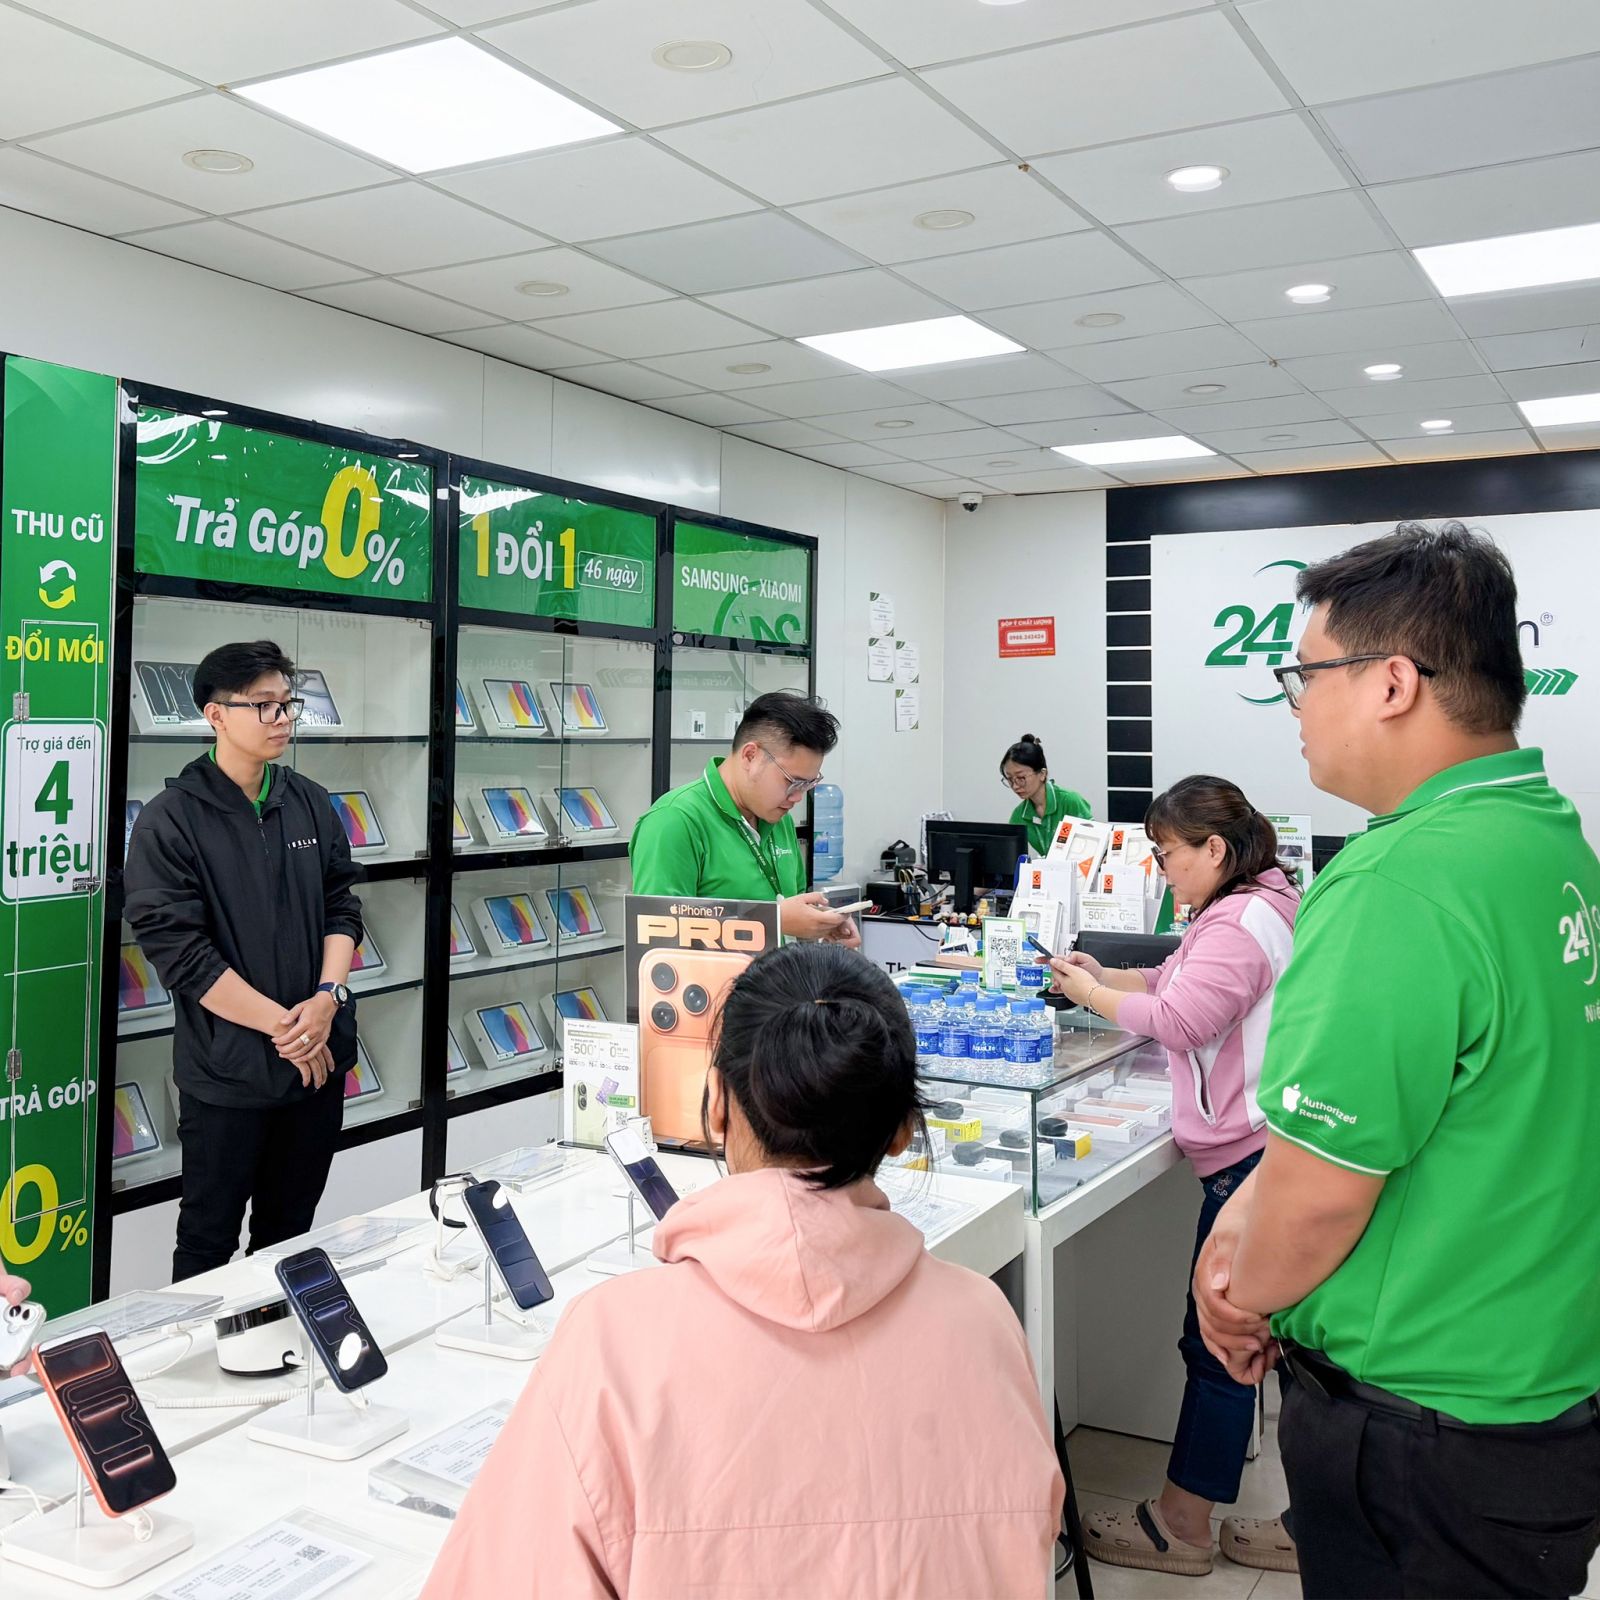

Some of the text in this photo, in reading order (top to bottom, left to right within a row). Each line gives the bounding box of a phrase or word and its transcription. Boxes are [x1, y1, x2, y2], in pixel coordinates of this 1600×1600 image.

[11, 508, 104, 543] THU CŨ
[173, 494, 238, 549] Trả
[248, 507, 325, 569] Góp
[495, 520, 554, 582] ĐỔI
[559, 527, 576, 590] 1
[584, 558, 639, 589] 46 ngày
[681, 565, 749, 595] SAMSUNG
[759, 578, 802, 603] XIAOMI
[5, 628, 104, 664] ĐỔI MỚI
[17, 734, 91, 754] Trợ giá đến
[34, 760, 74, 825] 4
[6, 832, 91, 883] triệu
[678, 904, 725, 917] iPhone 17
[637, 914, 766, 952] PRO
[0, 1076, 97, 1121] TRẢ GÓP
[1301, 1095, 1358, 1125] Authorized
[1299, 1108, 1338, 1129] Reseller
